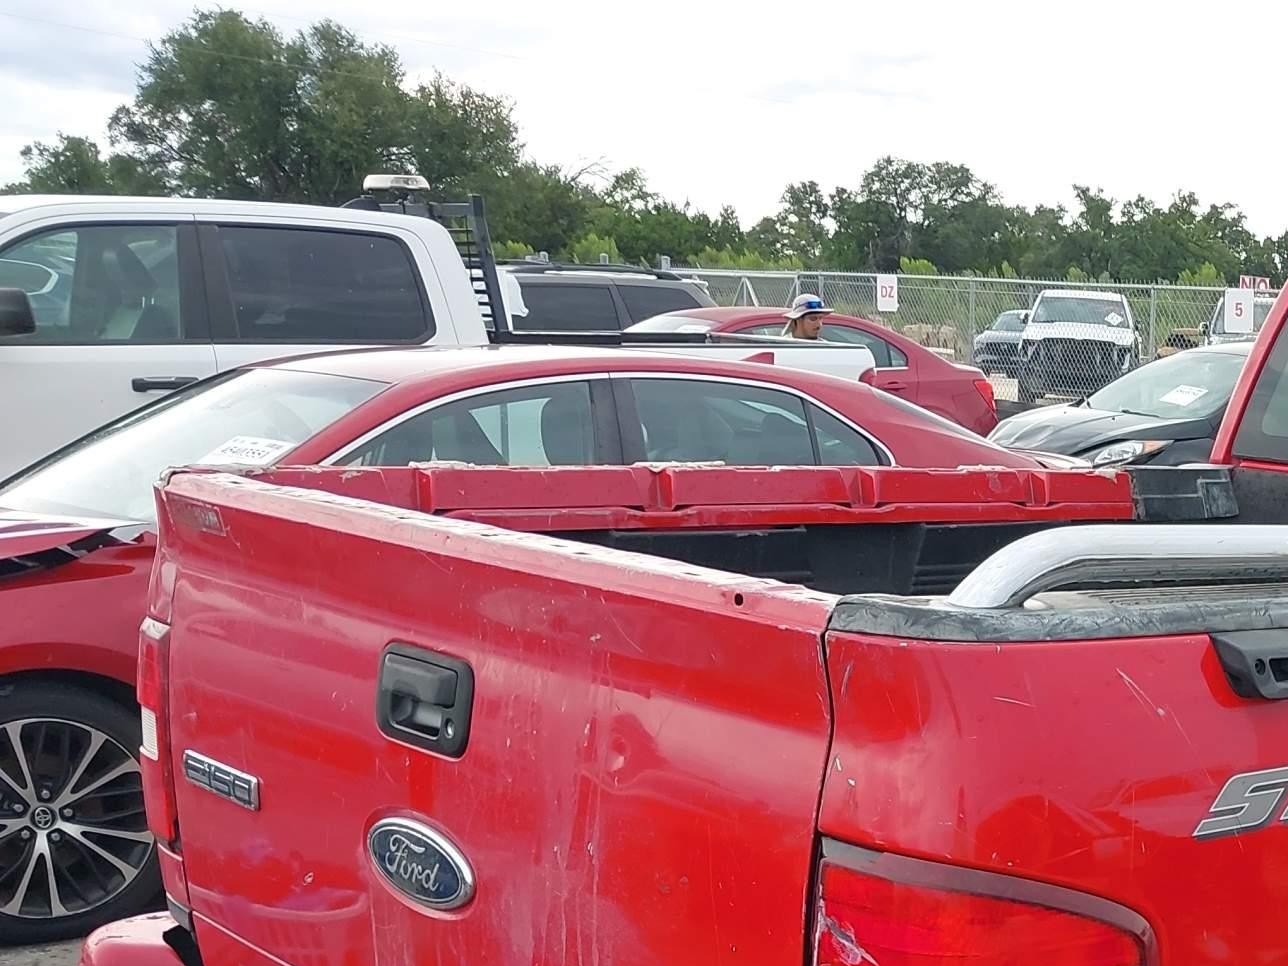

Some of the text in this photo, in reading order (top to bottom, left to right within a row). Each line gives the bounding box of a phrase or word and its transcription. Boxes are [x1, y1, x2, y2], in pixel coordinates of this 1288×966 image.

[880, 285, 895, 298] DZ
[1234, 302, 1243, 317] 5
[385, 834, 439, 891] Ford
